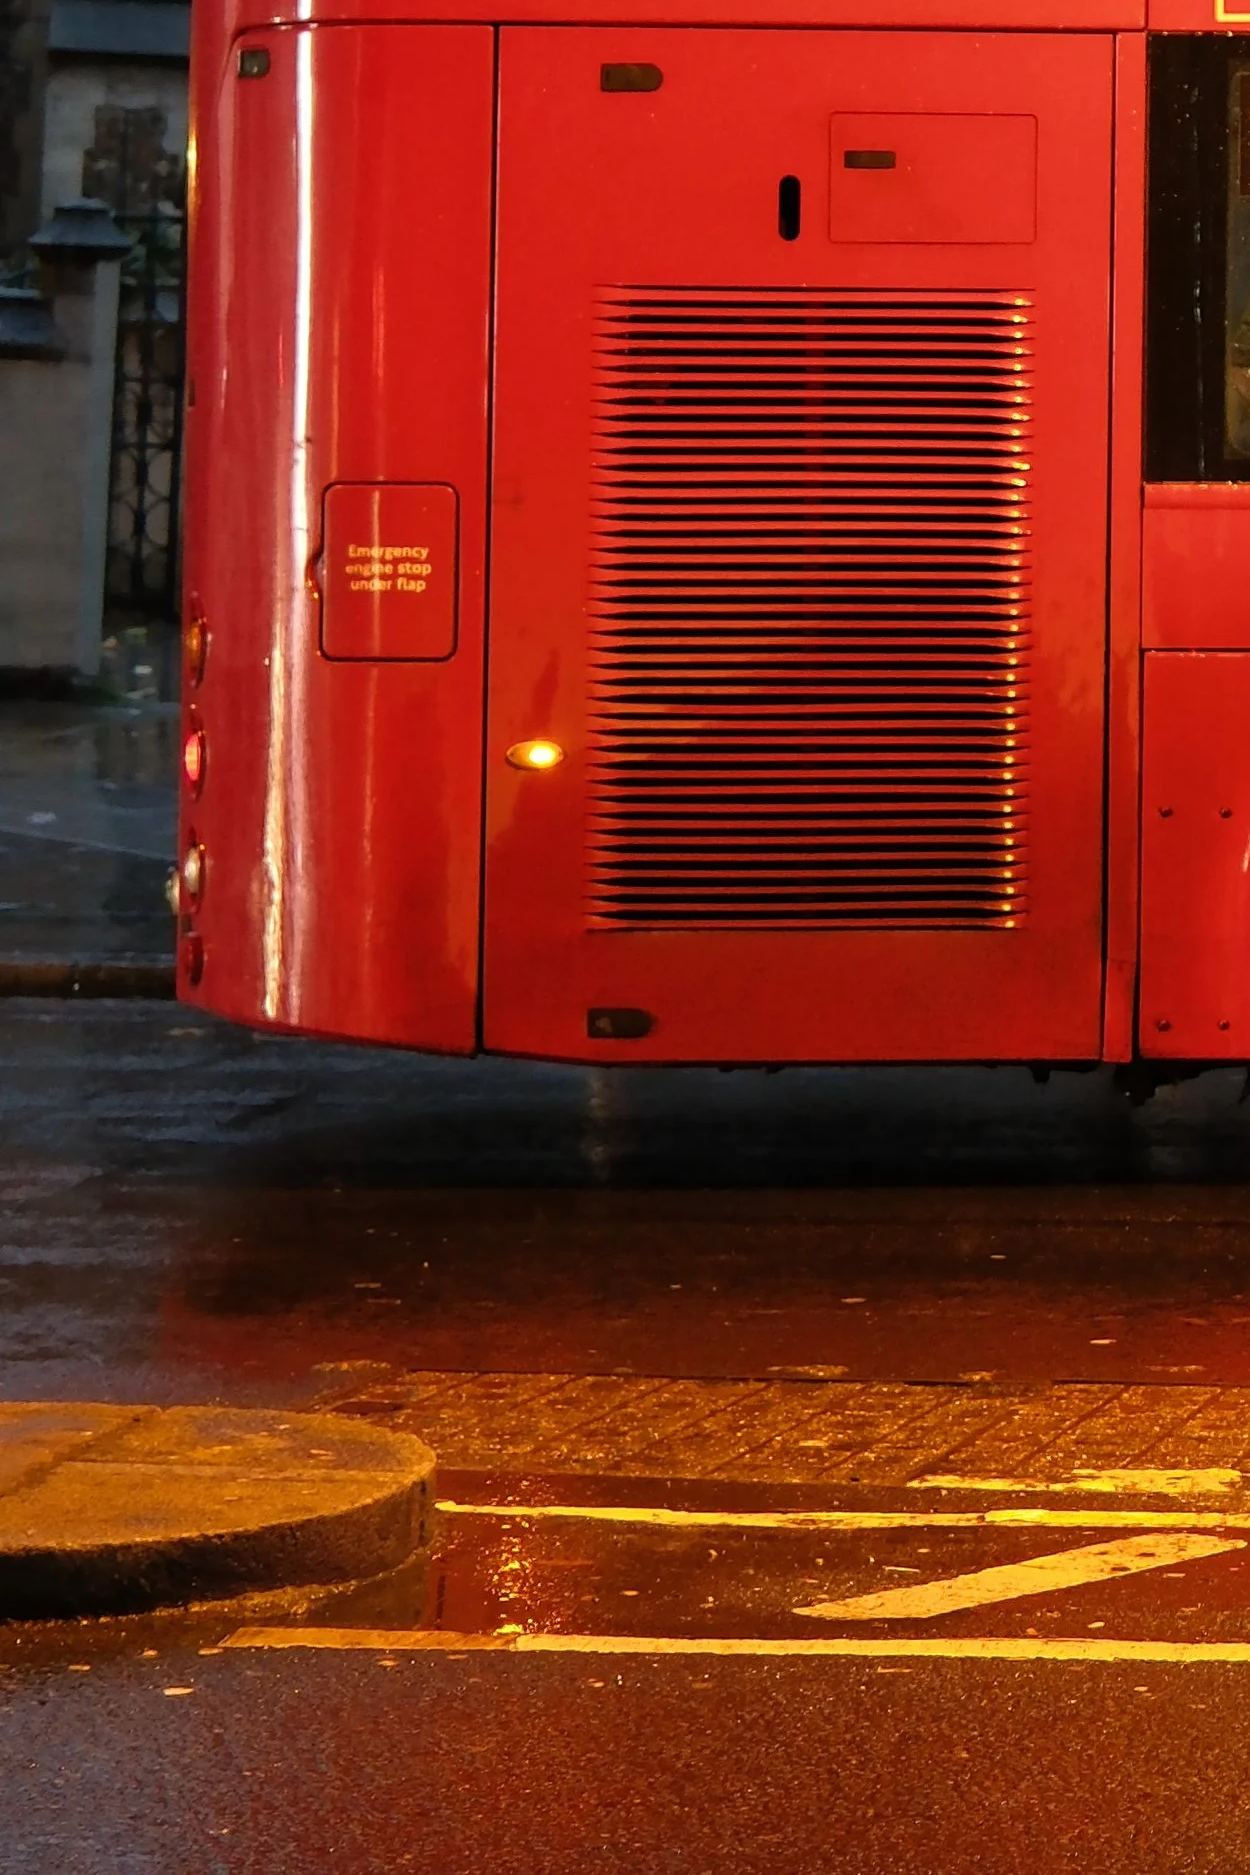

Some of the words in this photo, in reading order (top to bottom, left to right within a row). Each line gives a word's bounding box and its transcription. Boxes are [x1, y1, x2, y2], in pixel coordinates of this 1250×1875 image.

[348, 544, 429, 561] Emergency
[345, 563, 394, 577] engine
[397, 562, 432, 576] stop
[350, 577, 393, 591] under
[397, 577, 427, 593] flap
